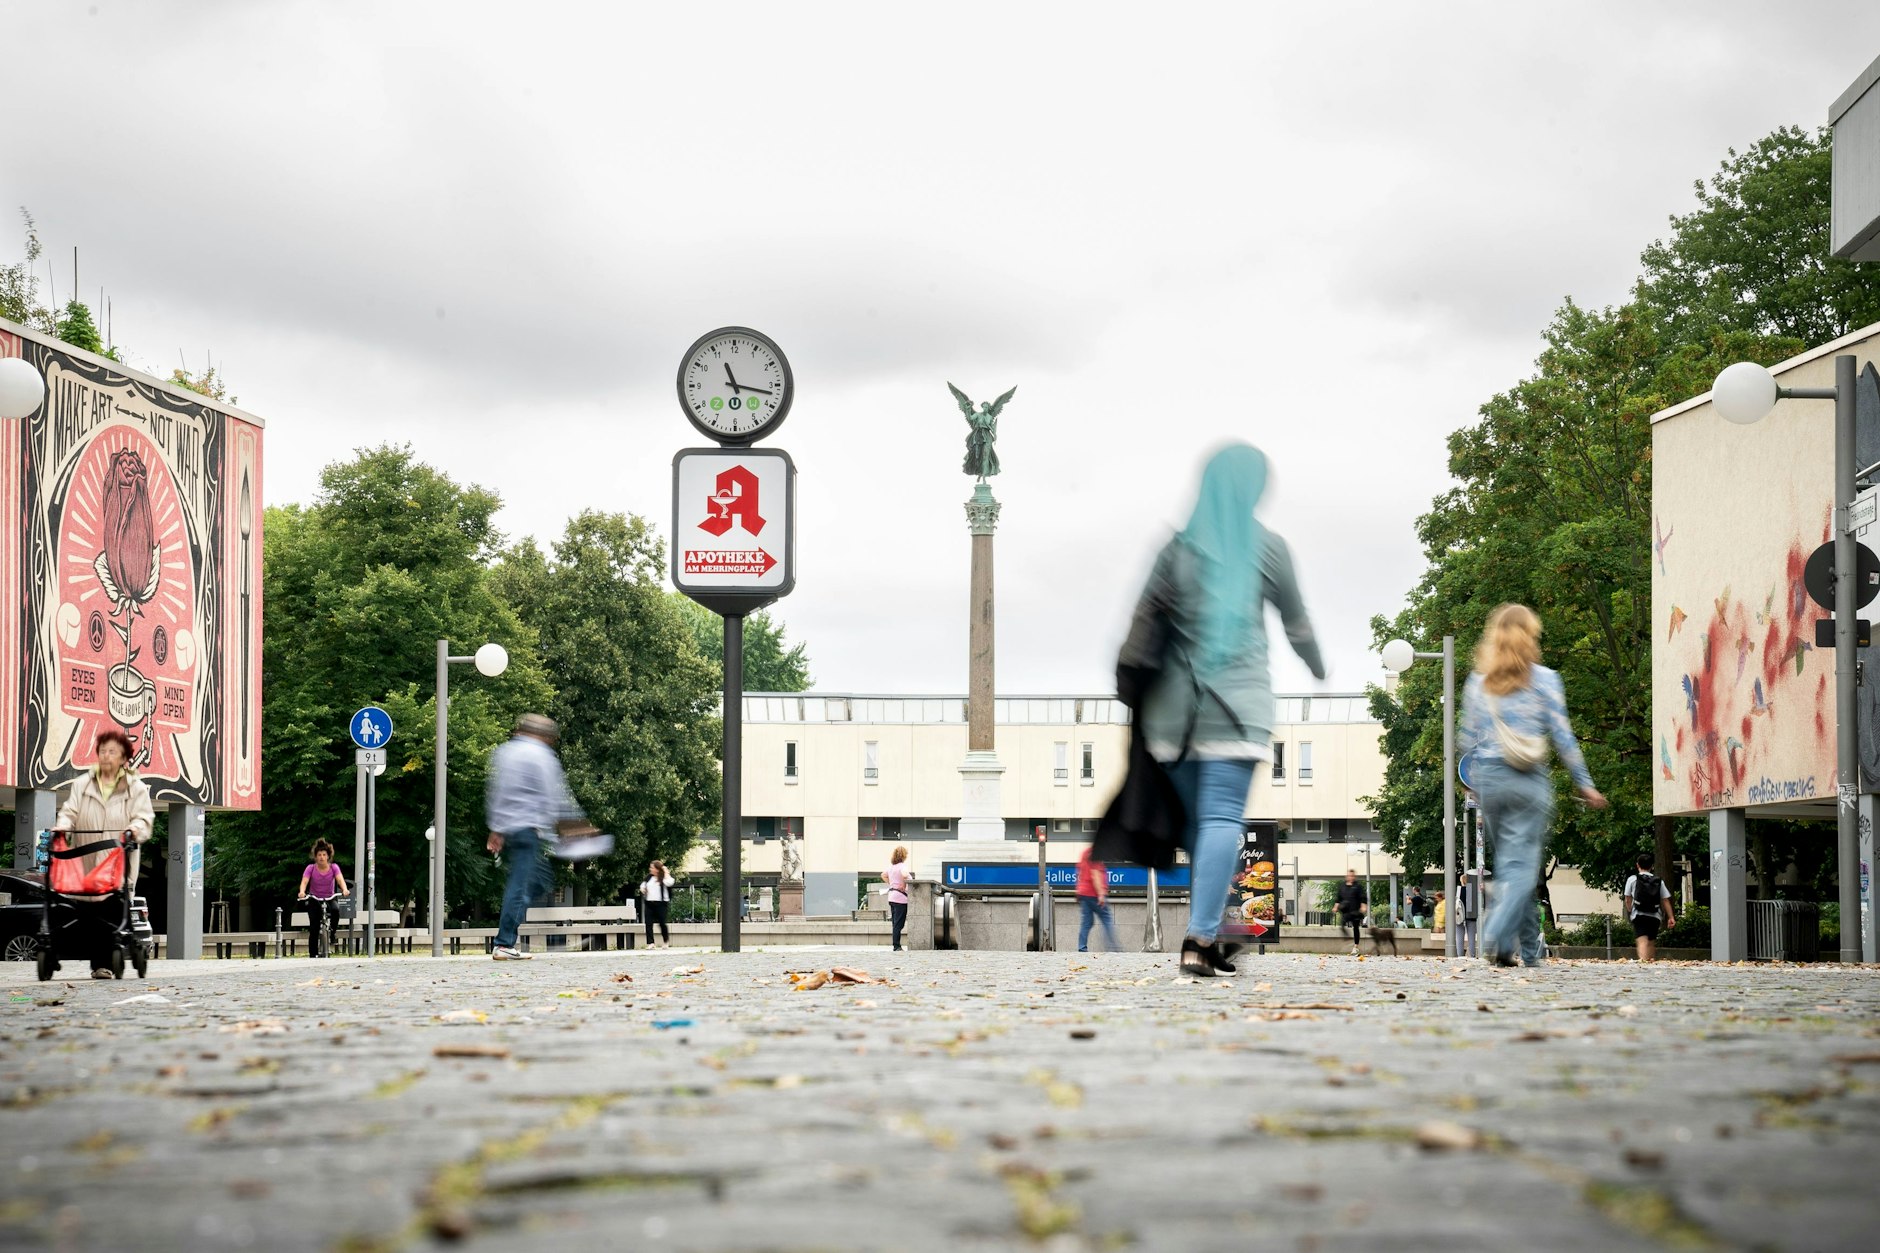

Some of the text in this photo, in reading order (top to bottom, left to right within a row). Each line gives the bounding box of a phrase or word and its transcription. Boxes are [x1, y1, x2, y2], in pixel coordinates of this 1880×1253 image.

[731, 346, 739, 354] 12
[702, 400, 707, 408] 8
[54, 375, 114, 473] MAKE ART
[715, 413, 720, 421] 7
[733, 418, 738, 426] 6
[150, 412, 200, 518] NOT WAR
[686, 551, 765, 564] APOTHEKE
[701, 565, 765, 573] MEHRINGPLATZ
[71, 668, 96, 685] EYES
[71, 686, 96, 704] OPEN
[164, 686, 186, 702] MIND
[111, 696, 141, 717] RISE ABOVE
[163, 703, 186, 719] OPEN
[365, 753, 371, 762] 9
[1240, 849, 1265, 860] Kebap
[949, 867, 1125, 883] U Halles Tor
